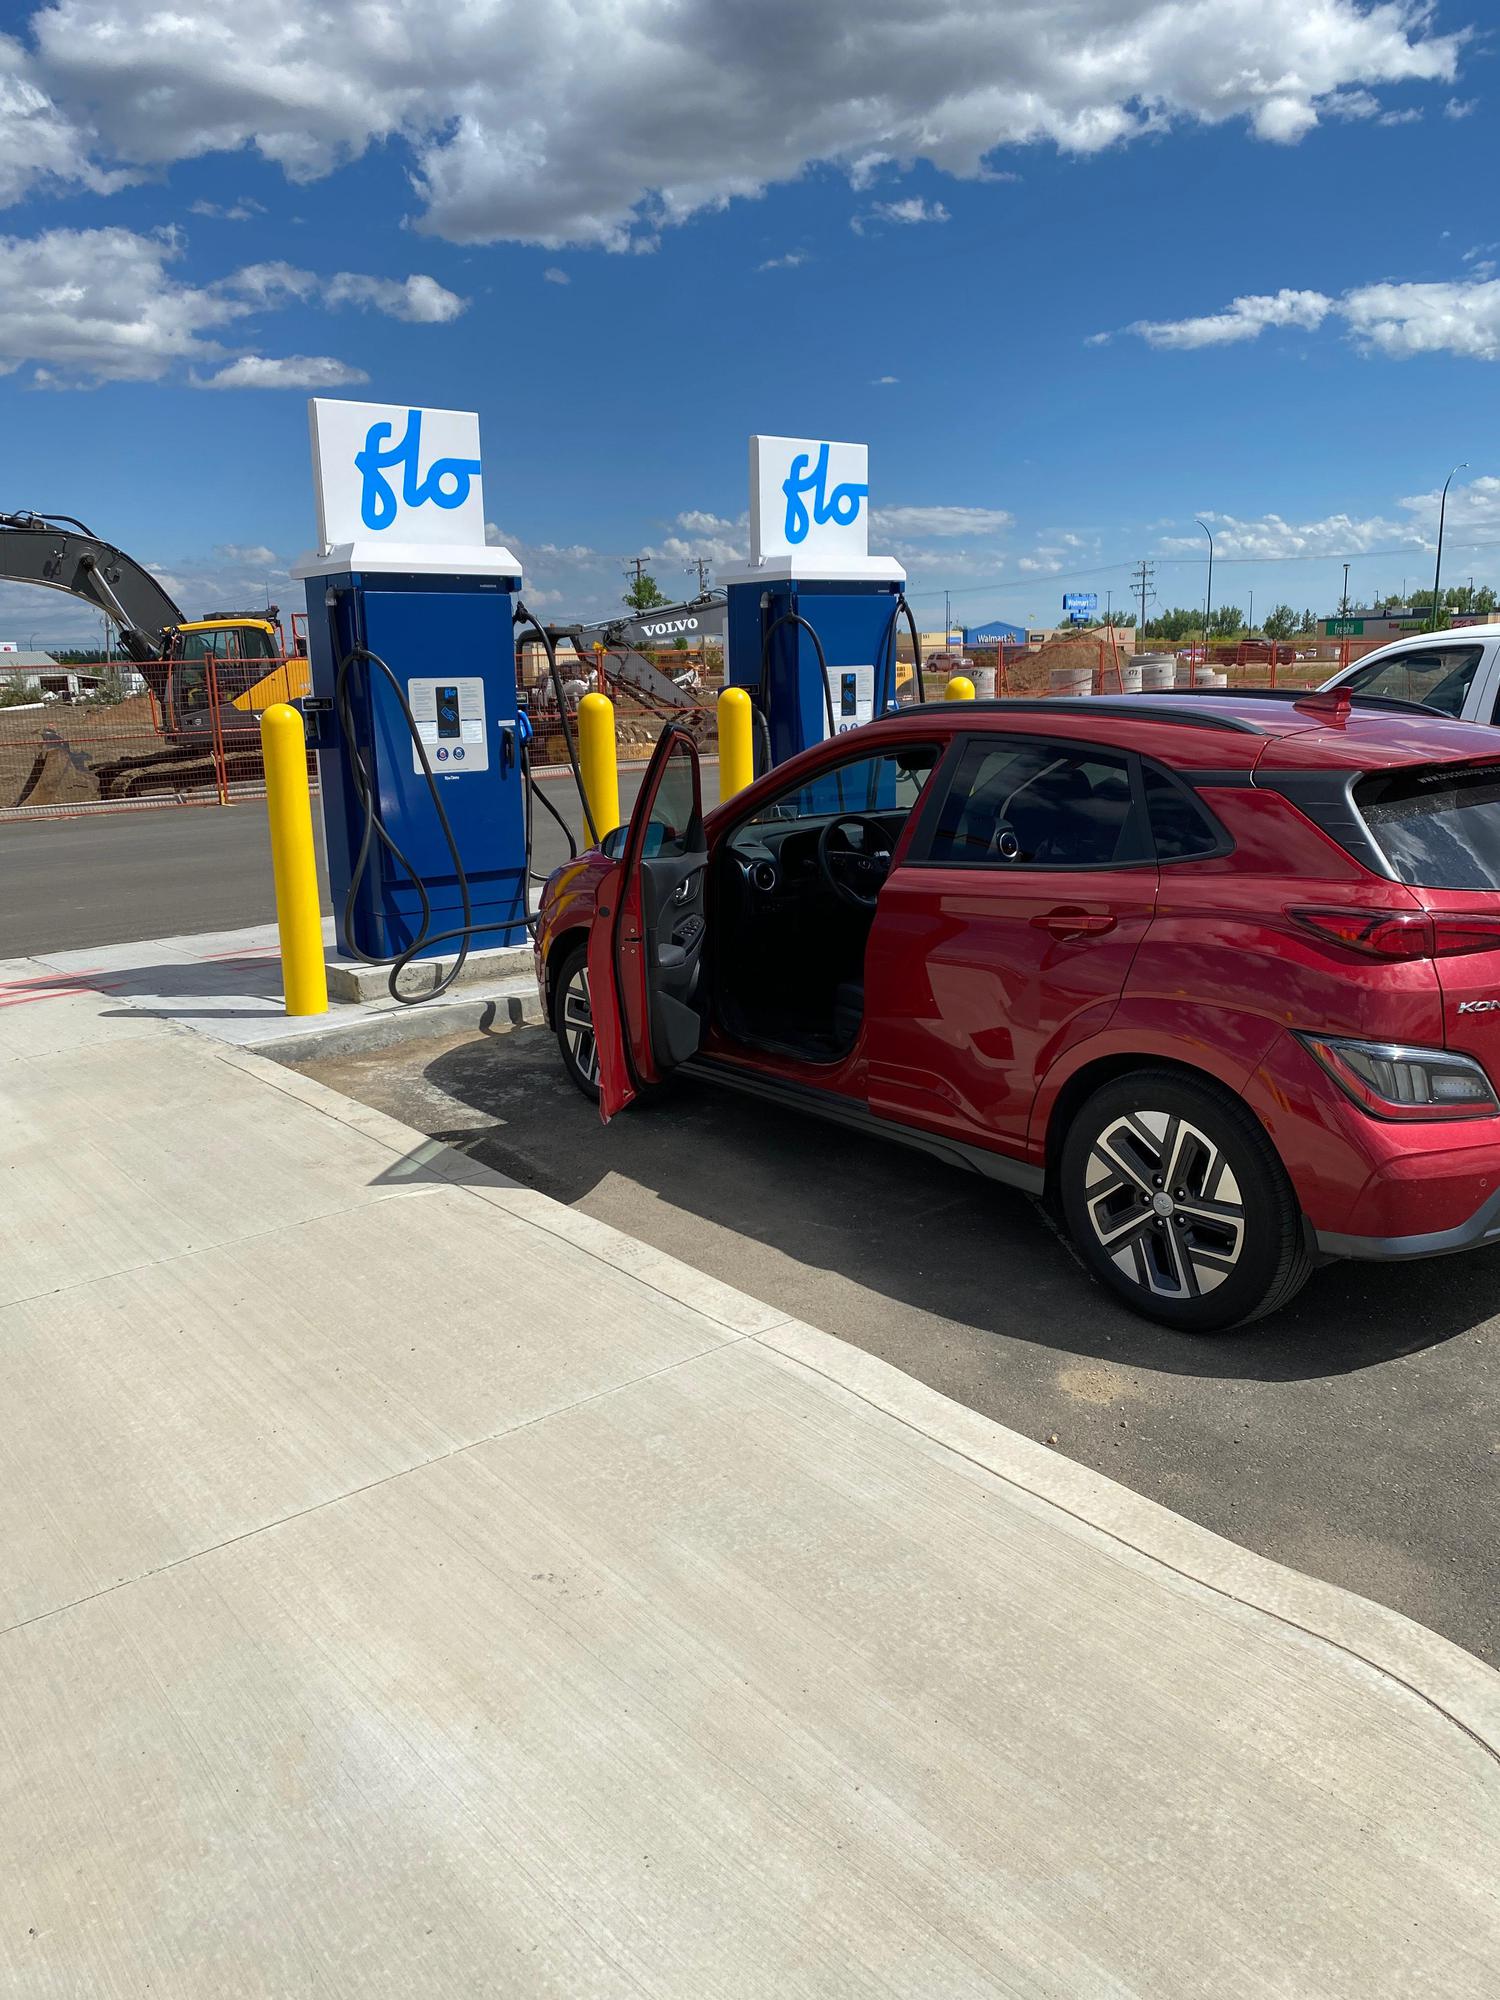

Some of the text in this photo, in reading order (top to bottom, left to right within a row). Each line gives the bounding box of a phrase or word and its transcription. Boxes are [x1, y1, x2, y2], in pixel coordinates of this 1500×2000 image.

[355, 410, 480, 530] flo
[783, 444, 868, 544] flo
[641, 618, 699, 637] VOLVO
[977, 634, 1007, 643] Walmart
